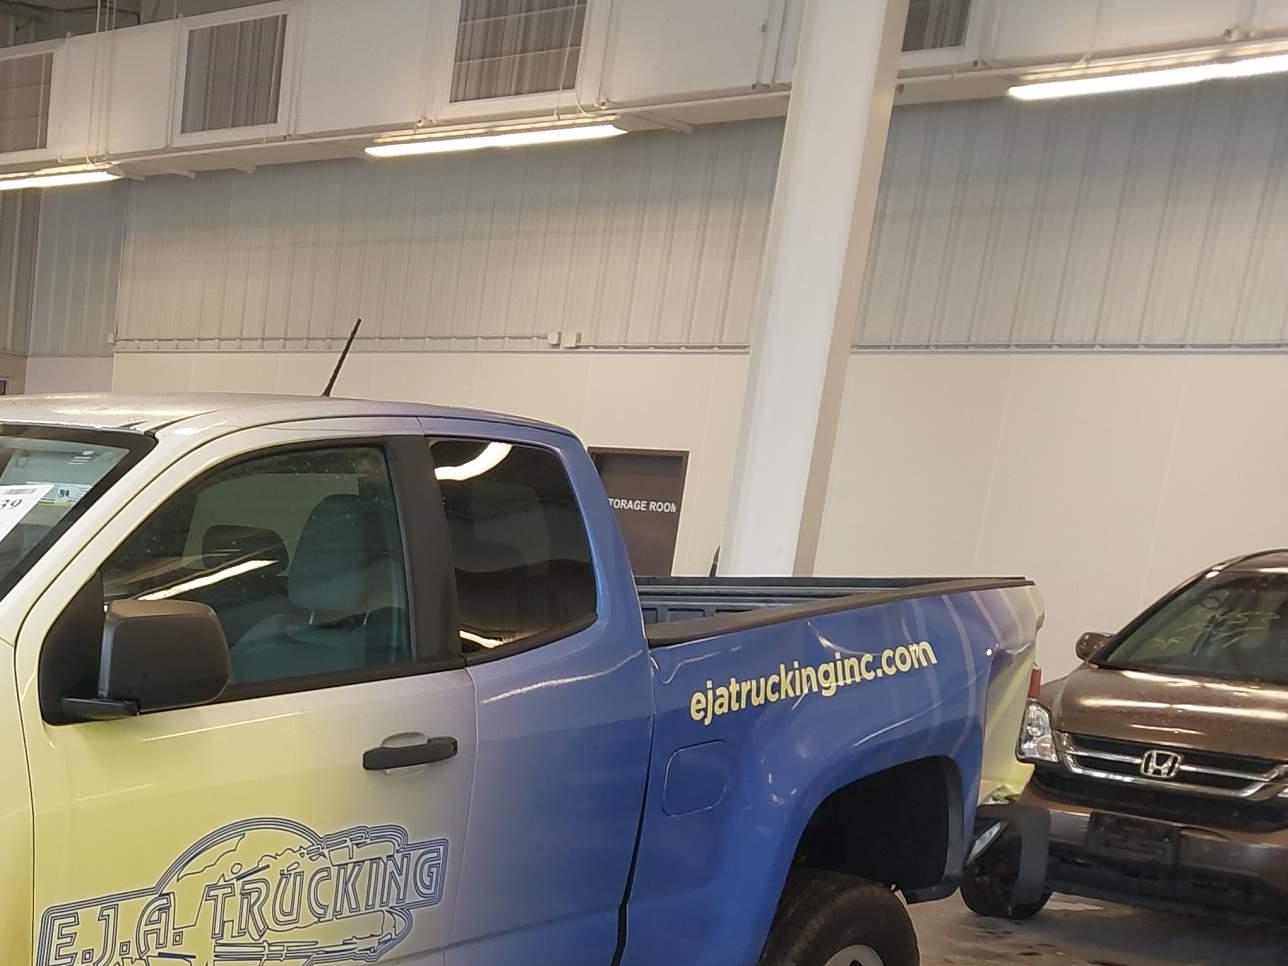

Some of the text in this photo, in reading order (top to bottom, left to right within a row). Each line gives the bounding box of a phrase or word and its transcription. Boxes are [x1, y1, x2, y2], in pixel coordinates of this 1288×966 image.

[608, 498, 648, 511] TORAGE
[689, 640, 938, 726] ejatruckinginc.com
[205, 847, 443, 941] TRUCKING
